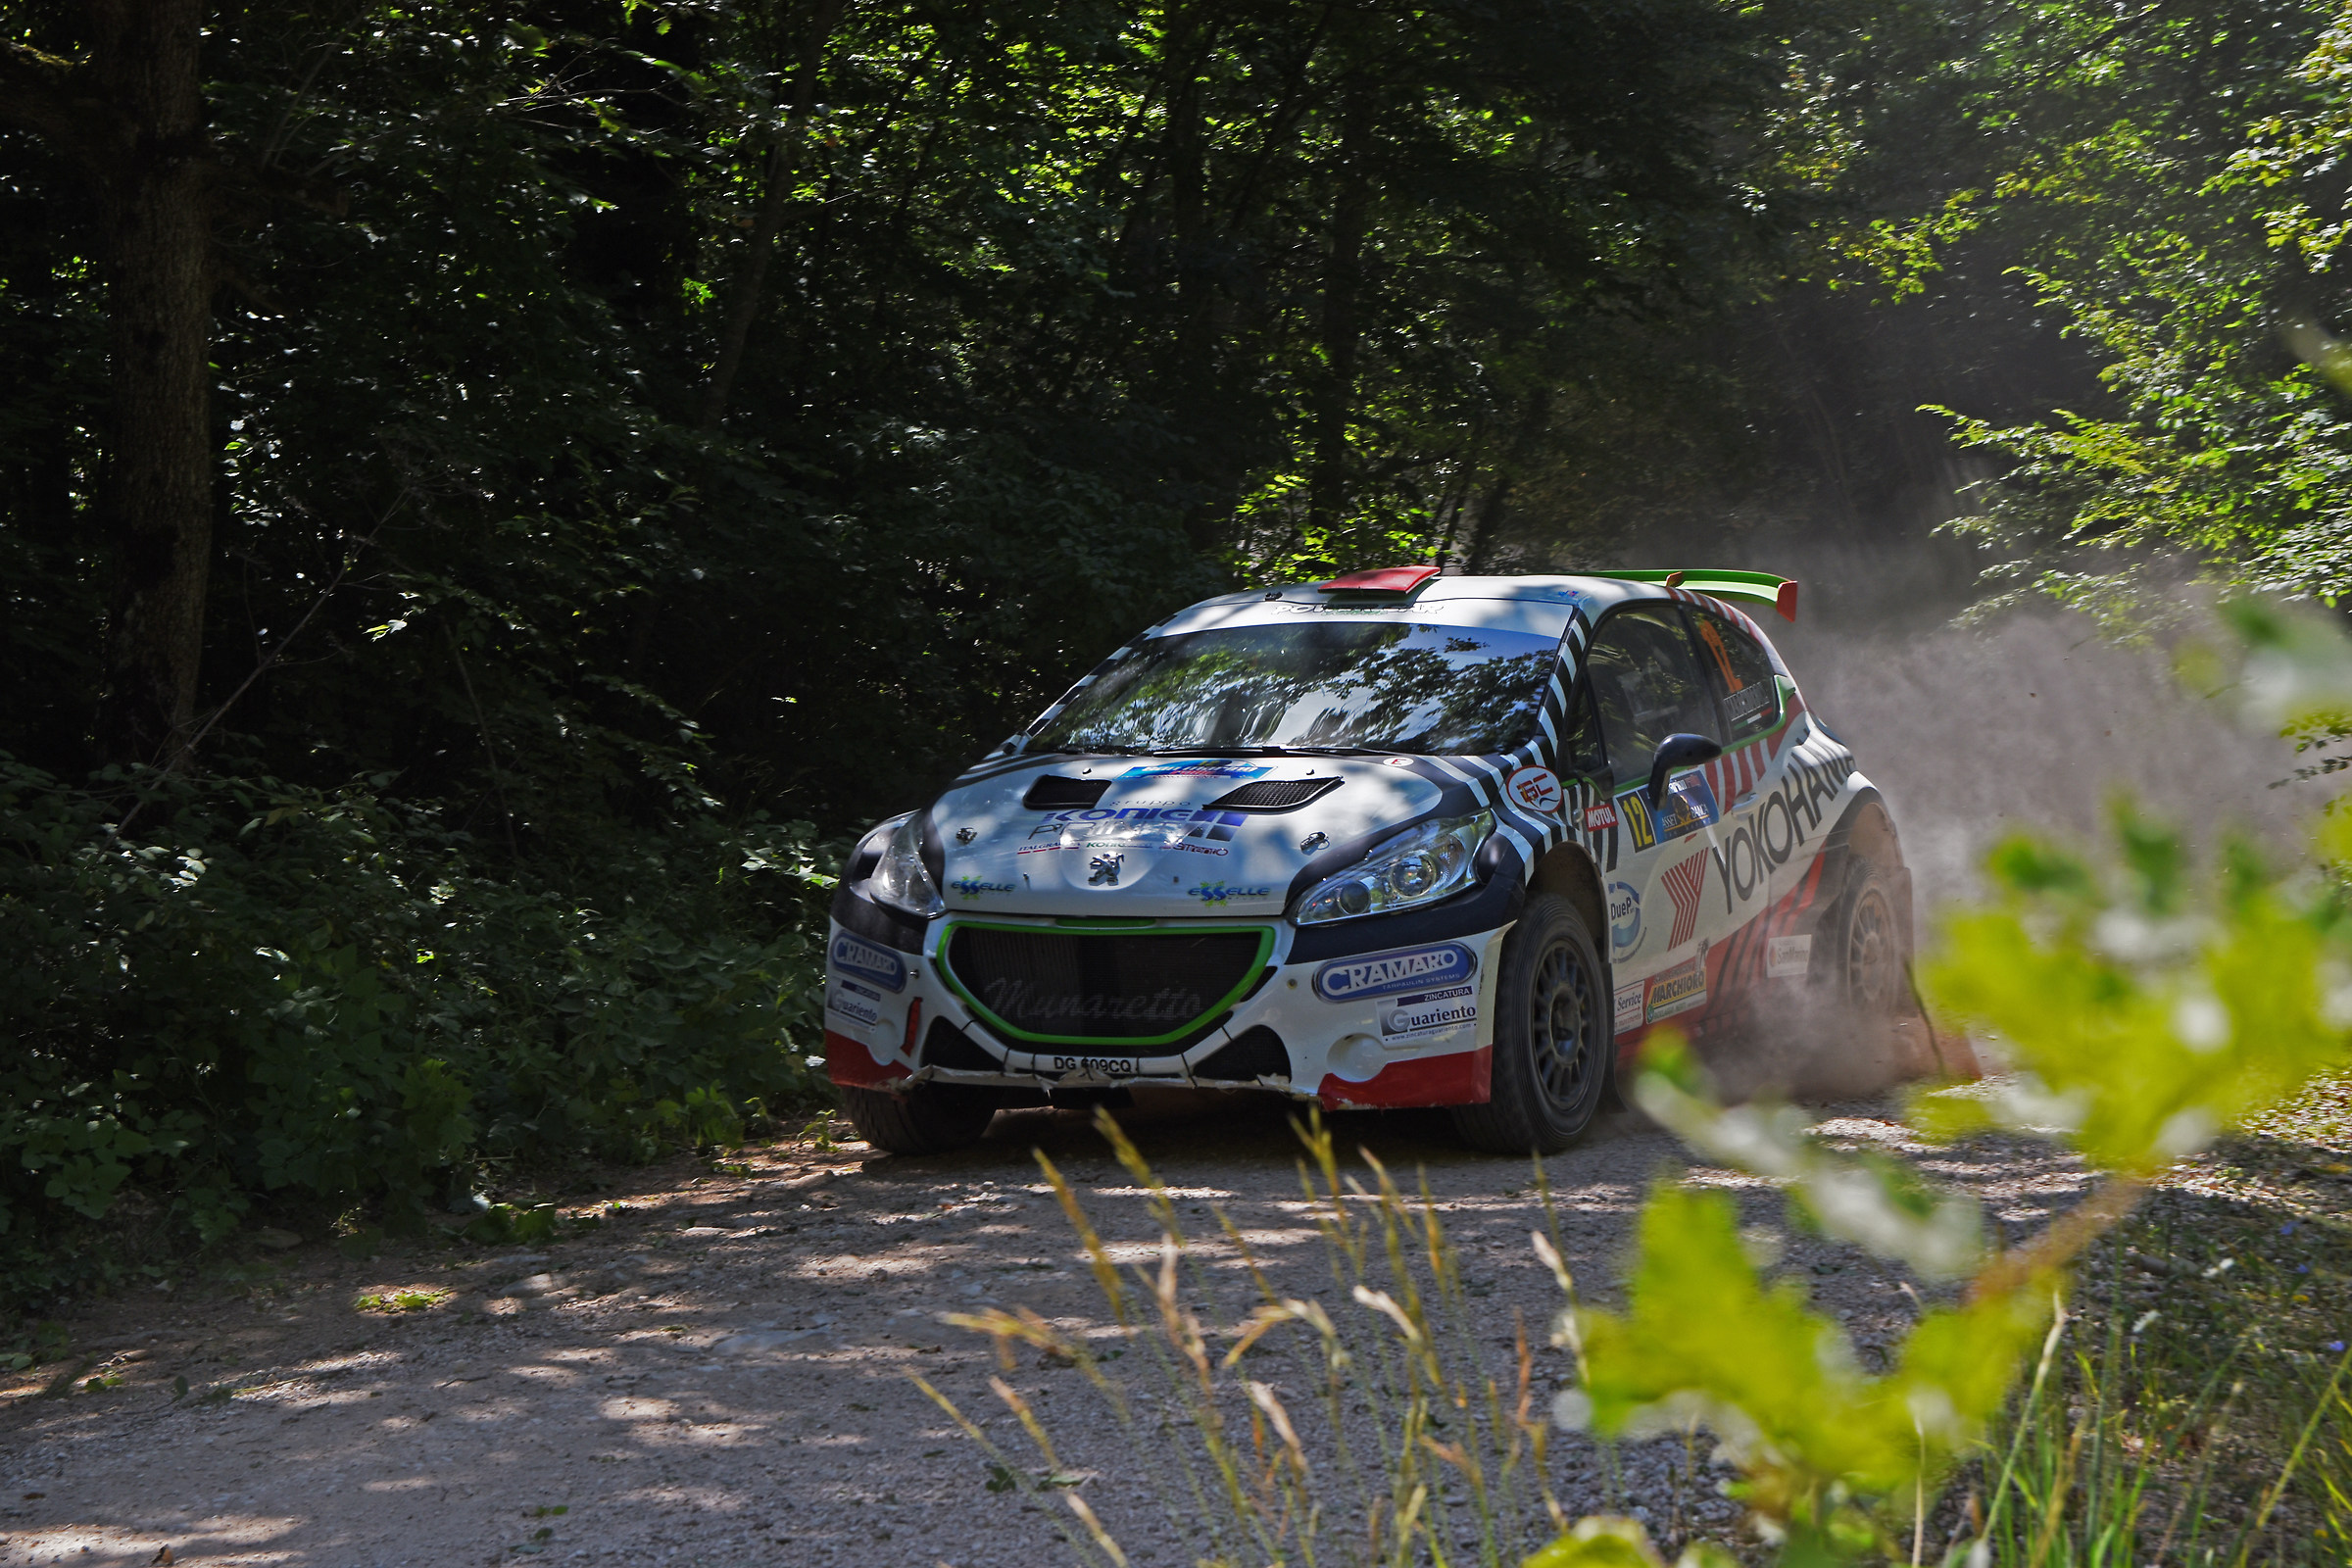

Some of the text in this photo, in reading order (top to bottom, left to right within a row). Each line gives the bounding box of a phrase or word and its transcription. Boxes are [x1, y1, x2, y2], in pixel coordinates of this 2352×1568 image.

[1588, 807, 1616, 828] MOTUL
[1623, 796, 1653, 848] 12
[1610, 897, 1632, 921] DueP
[1322, 949, 1458, 997] CRAMARO
[1382, 972, 1461, 991] TARPAULIN SYSTEMS
[1423, 987, 1470, 1002] ZINCATURA
[1650, 970, 1706, 1004] MARCHIORO
[1616, 992, 1642, 1011] Service
[1388, 1004, 1477, 1032] Guariento
[1054, 1056, 1076, 1070] DG
